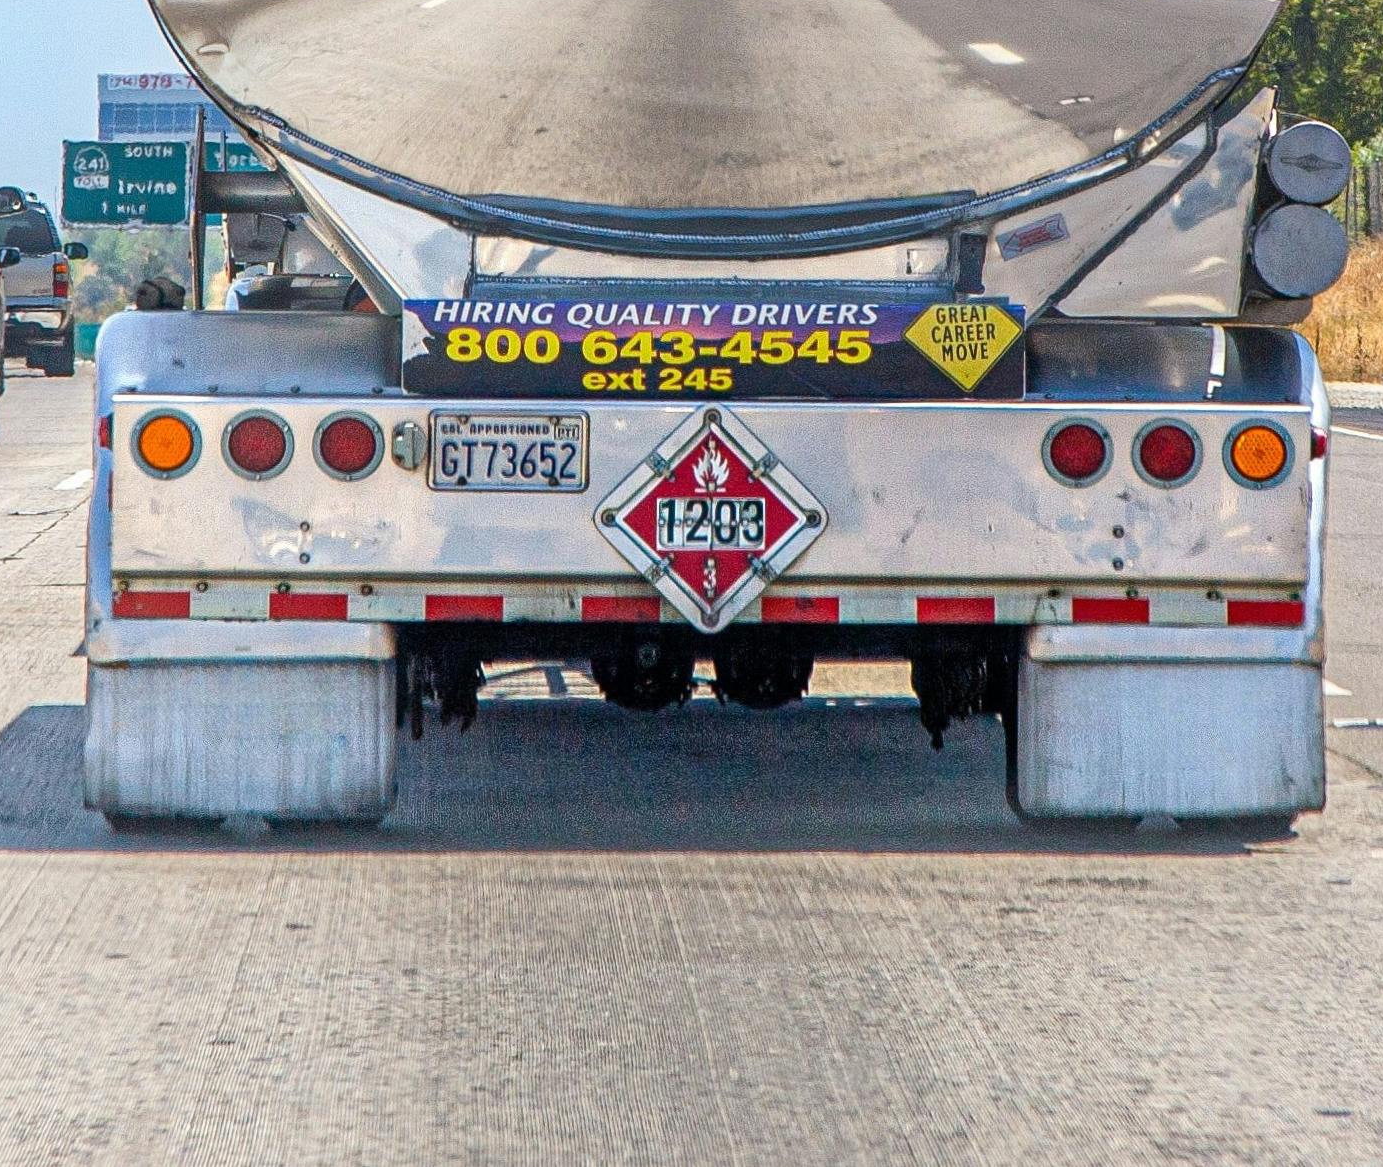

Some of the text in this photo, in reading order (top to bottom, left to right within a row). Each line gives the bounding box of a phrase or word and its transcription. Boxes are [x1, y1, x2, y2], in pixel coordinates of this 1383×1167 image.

[139, 74, 194, 89] 978-7
[124, 145, 173, 158] SOUTH
[78, 157, 105, 171] 241
[118, 179, 177, 195] Irvine
[117, 204, 146, 215] MILE
[433, 301, 880, 328] HIRING QUALITY DRIVERS
[935, 305, 989, 325] GREAT
[931, 323, 996, 344] CAREER
[446, 327, 872, 365] 800 643-4545
[941, 342, 989, 362] MOVE
[581, 367, 734, 391] ext 245
[441, 424, 550, 435] CAL APPORTIONED
[441, 440, 576, 479] GT73652
[660, 499, 764, 544] 1203
[703, 565, 716, 593] 3
